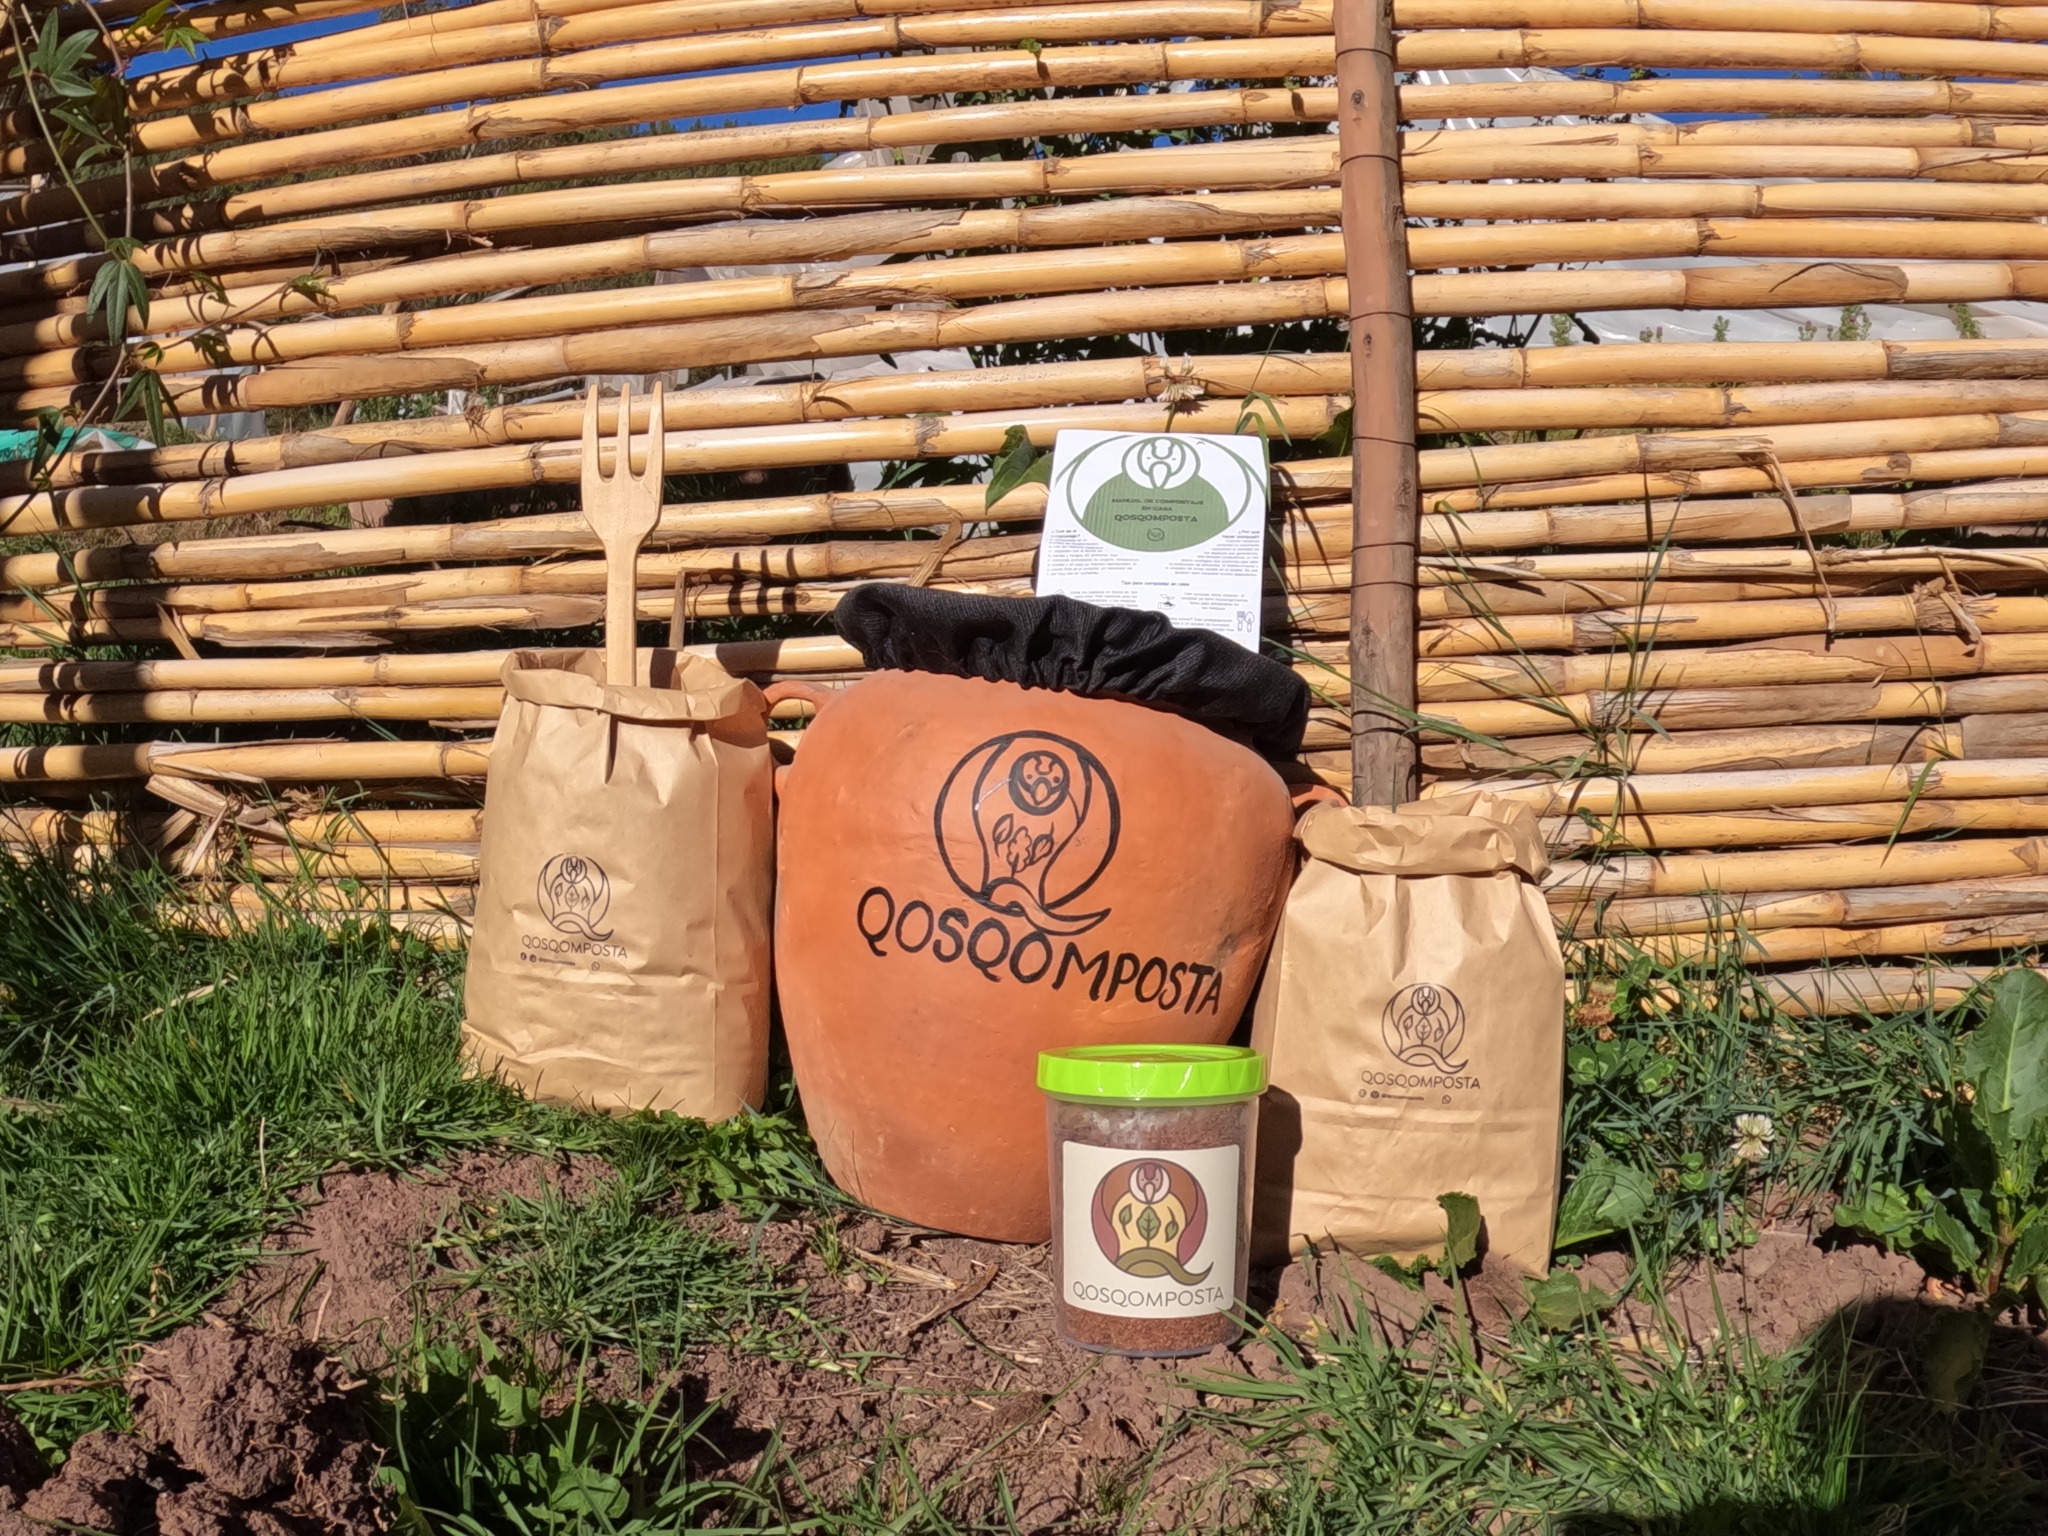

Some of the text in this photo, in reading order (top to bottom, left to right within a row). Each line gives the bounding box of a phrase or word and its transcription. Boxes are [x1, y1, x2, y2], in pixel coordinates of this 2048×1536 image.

[1114, 514, 1198, 522] QOSQOMPOSTA
[521, 934, 628, 959] QOSQOMPOSTA
[857, 886, 1223, 1015] QOSQOMPOSTA
[1361, 1070, 1481, 1089] QOSQOMPOSTA
[1073, 1281, 1224, 1308] QOSQOMPOSTA
